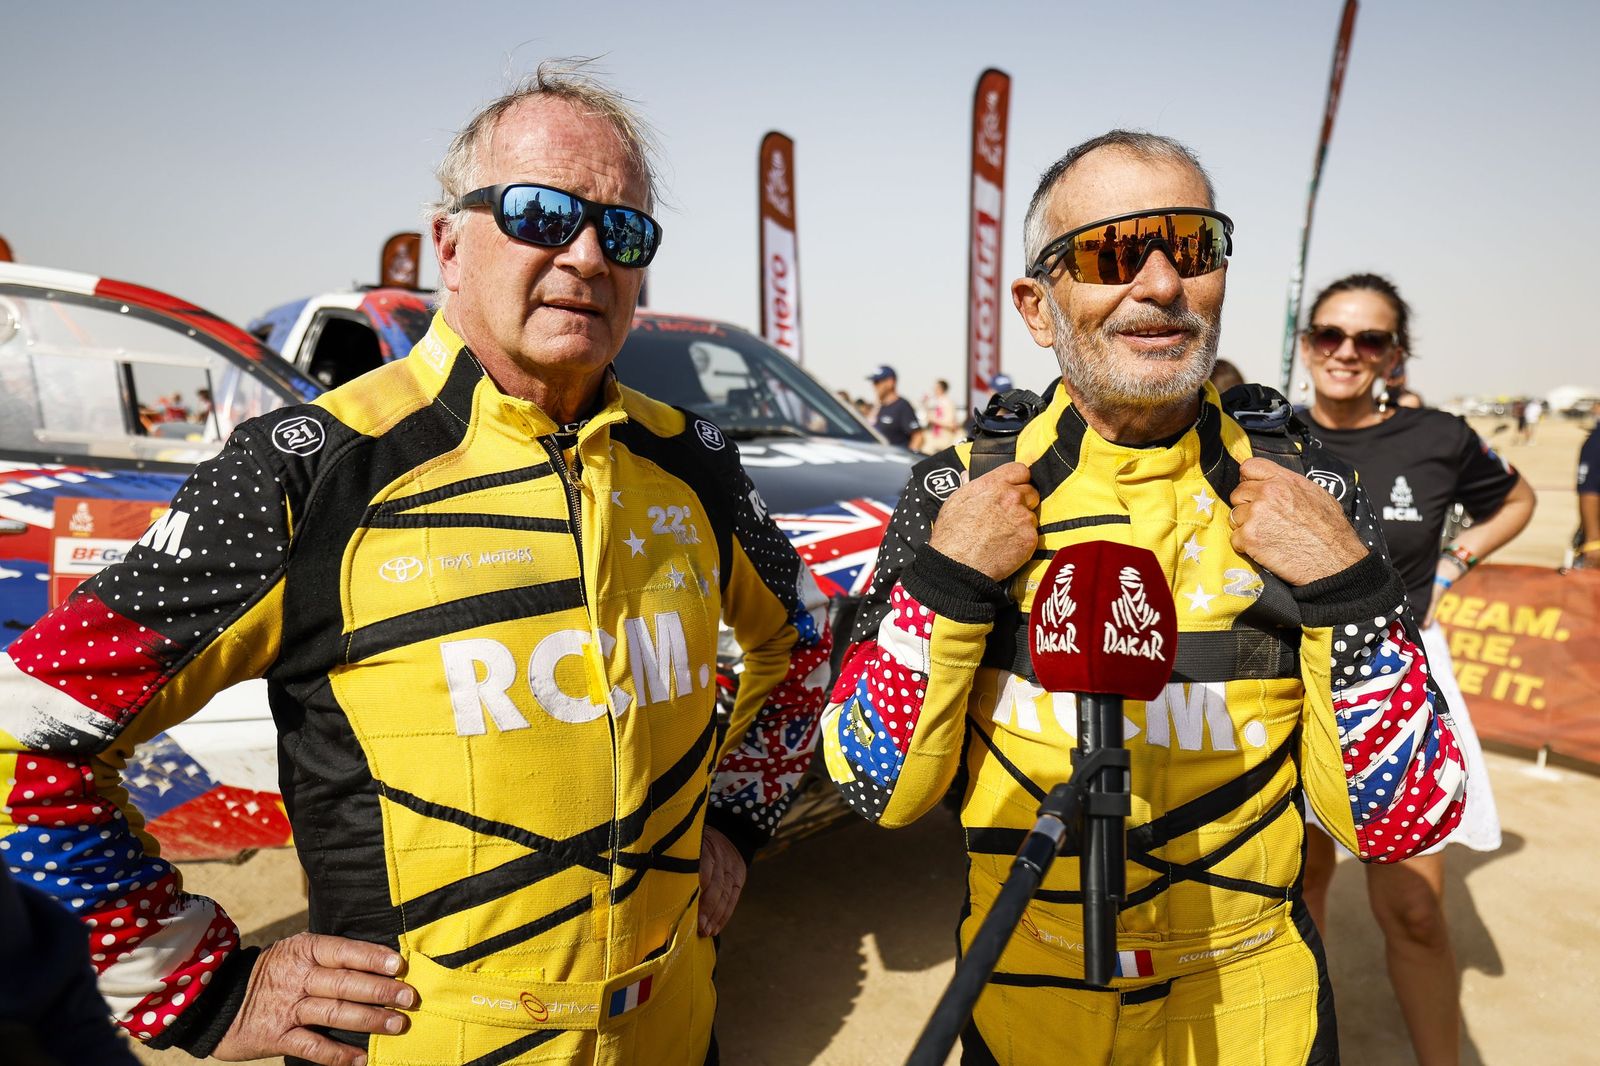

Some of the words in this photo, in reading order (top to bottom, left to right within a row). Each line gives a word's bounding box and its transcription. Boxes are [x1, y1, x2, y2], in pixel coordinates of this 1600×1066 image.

[772, 254, 792, 347] Hero
[283, 424, 316, 447] 21
[702, 427, 720, 442] 21
[932, 474, 955, 492] 21
[437, 553, 473, 570] TOYS
[479, 547, 533, 567] MOTORS
[1434, 592, 1570, 642] REAM.
[1036, 622, 1081, 655] DAKAR
[1103, 621, 1166, 662] DAKAR
[440, 611, 710, 736] RCM.
[1492, 671, 1546, 711] IT.
